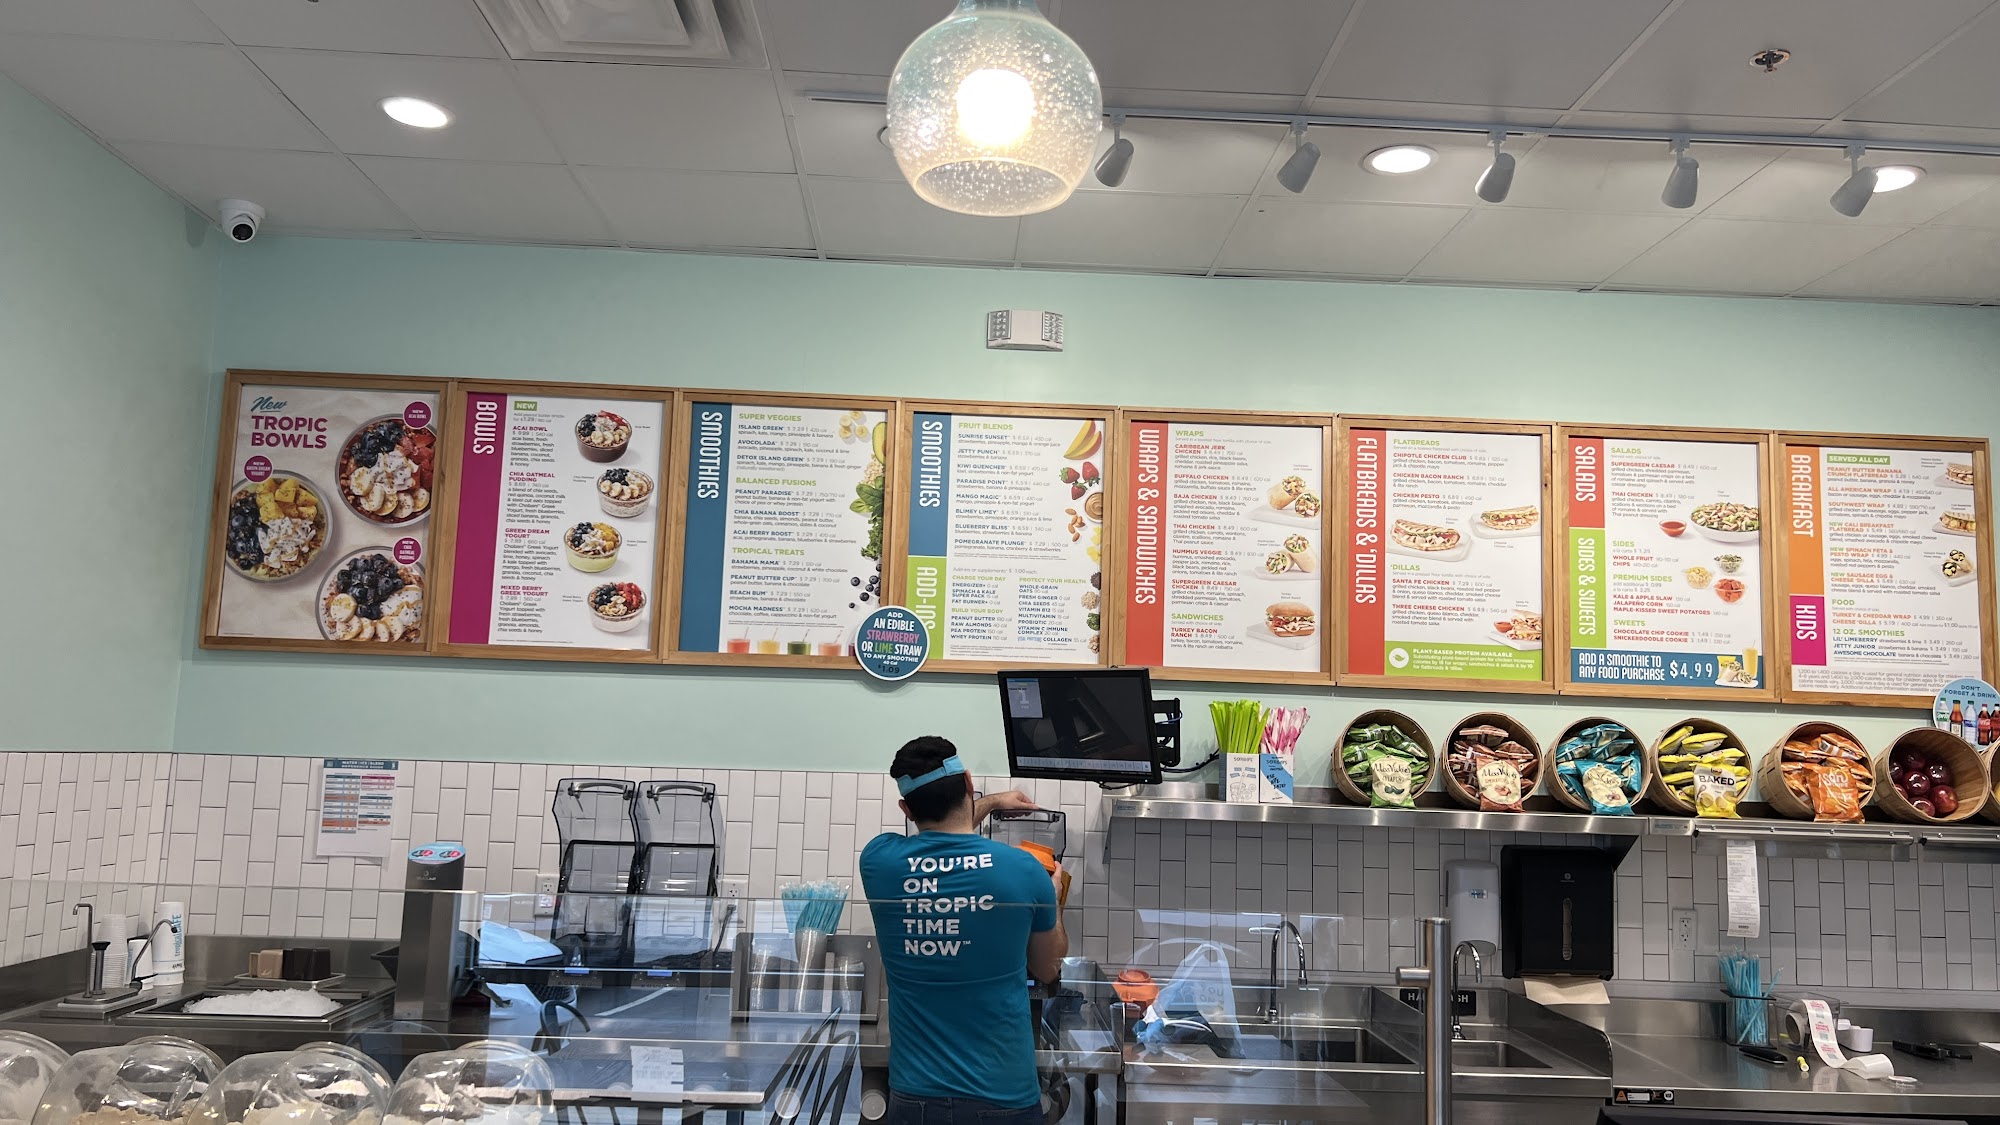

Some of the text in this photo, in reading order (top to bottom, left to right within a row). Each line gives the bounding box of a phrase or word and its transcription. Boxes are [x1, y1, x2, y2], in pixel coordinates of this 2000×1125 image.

[251, 396, 287, 412] New
[252, 416, 328, 432] TROPIC
[473, 401, 498, 454] BOWLS
[252, 432, 327, 449] BOWLS
[698, 412, 722, 499] SMOOTHIES
[919, 421, 943, 507] SMOOTHIES
[1356, 437, 1377, 528] FLATBREADS
[1575, 446, 1595, 502] SALADS
[1791, 454, 1813, 537] BREAKFAST
[1136, 429, 1159, 604] WRAPS & SANDWICHES
[1356, 533, 1377, 545] &
[1578, 538, 1596, 635] SIDES & SWEETS
[874, 618, 914, 631] AN EDIBLE
[1796, 604, 1817, 640] KIDS
[867, 630, 920, 644] STRAWBERRY
[862, 641, 922, 656] OR LIME STRAW
[1579, 653, 1661, 668] ADD A SMOOTHIE TO
[1579, 666, 1664, 681] ANY FOOD PURCHASE
[1670, 660, 1713, 679] $4.99
[1699, 775, 1735, 786] BAKED
[908, 854, 993, 872] YOU'RE
[904, 878, 938, 893] ON
[902, 895, 994, 913] TROPIC
[903, 919, 960, 934] TIME
